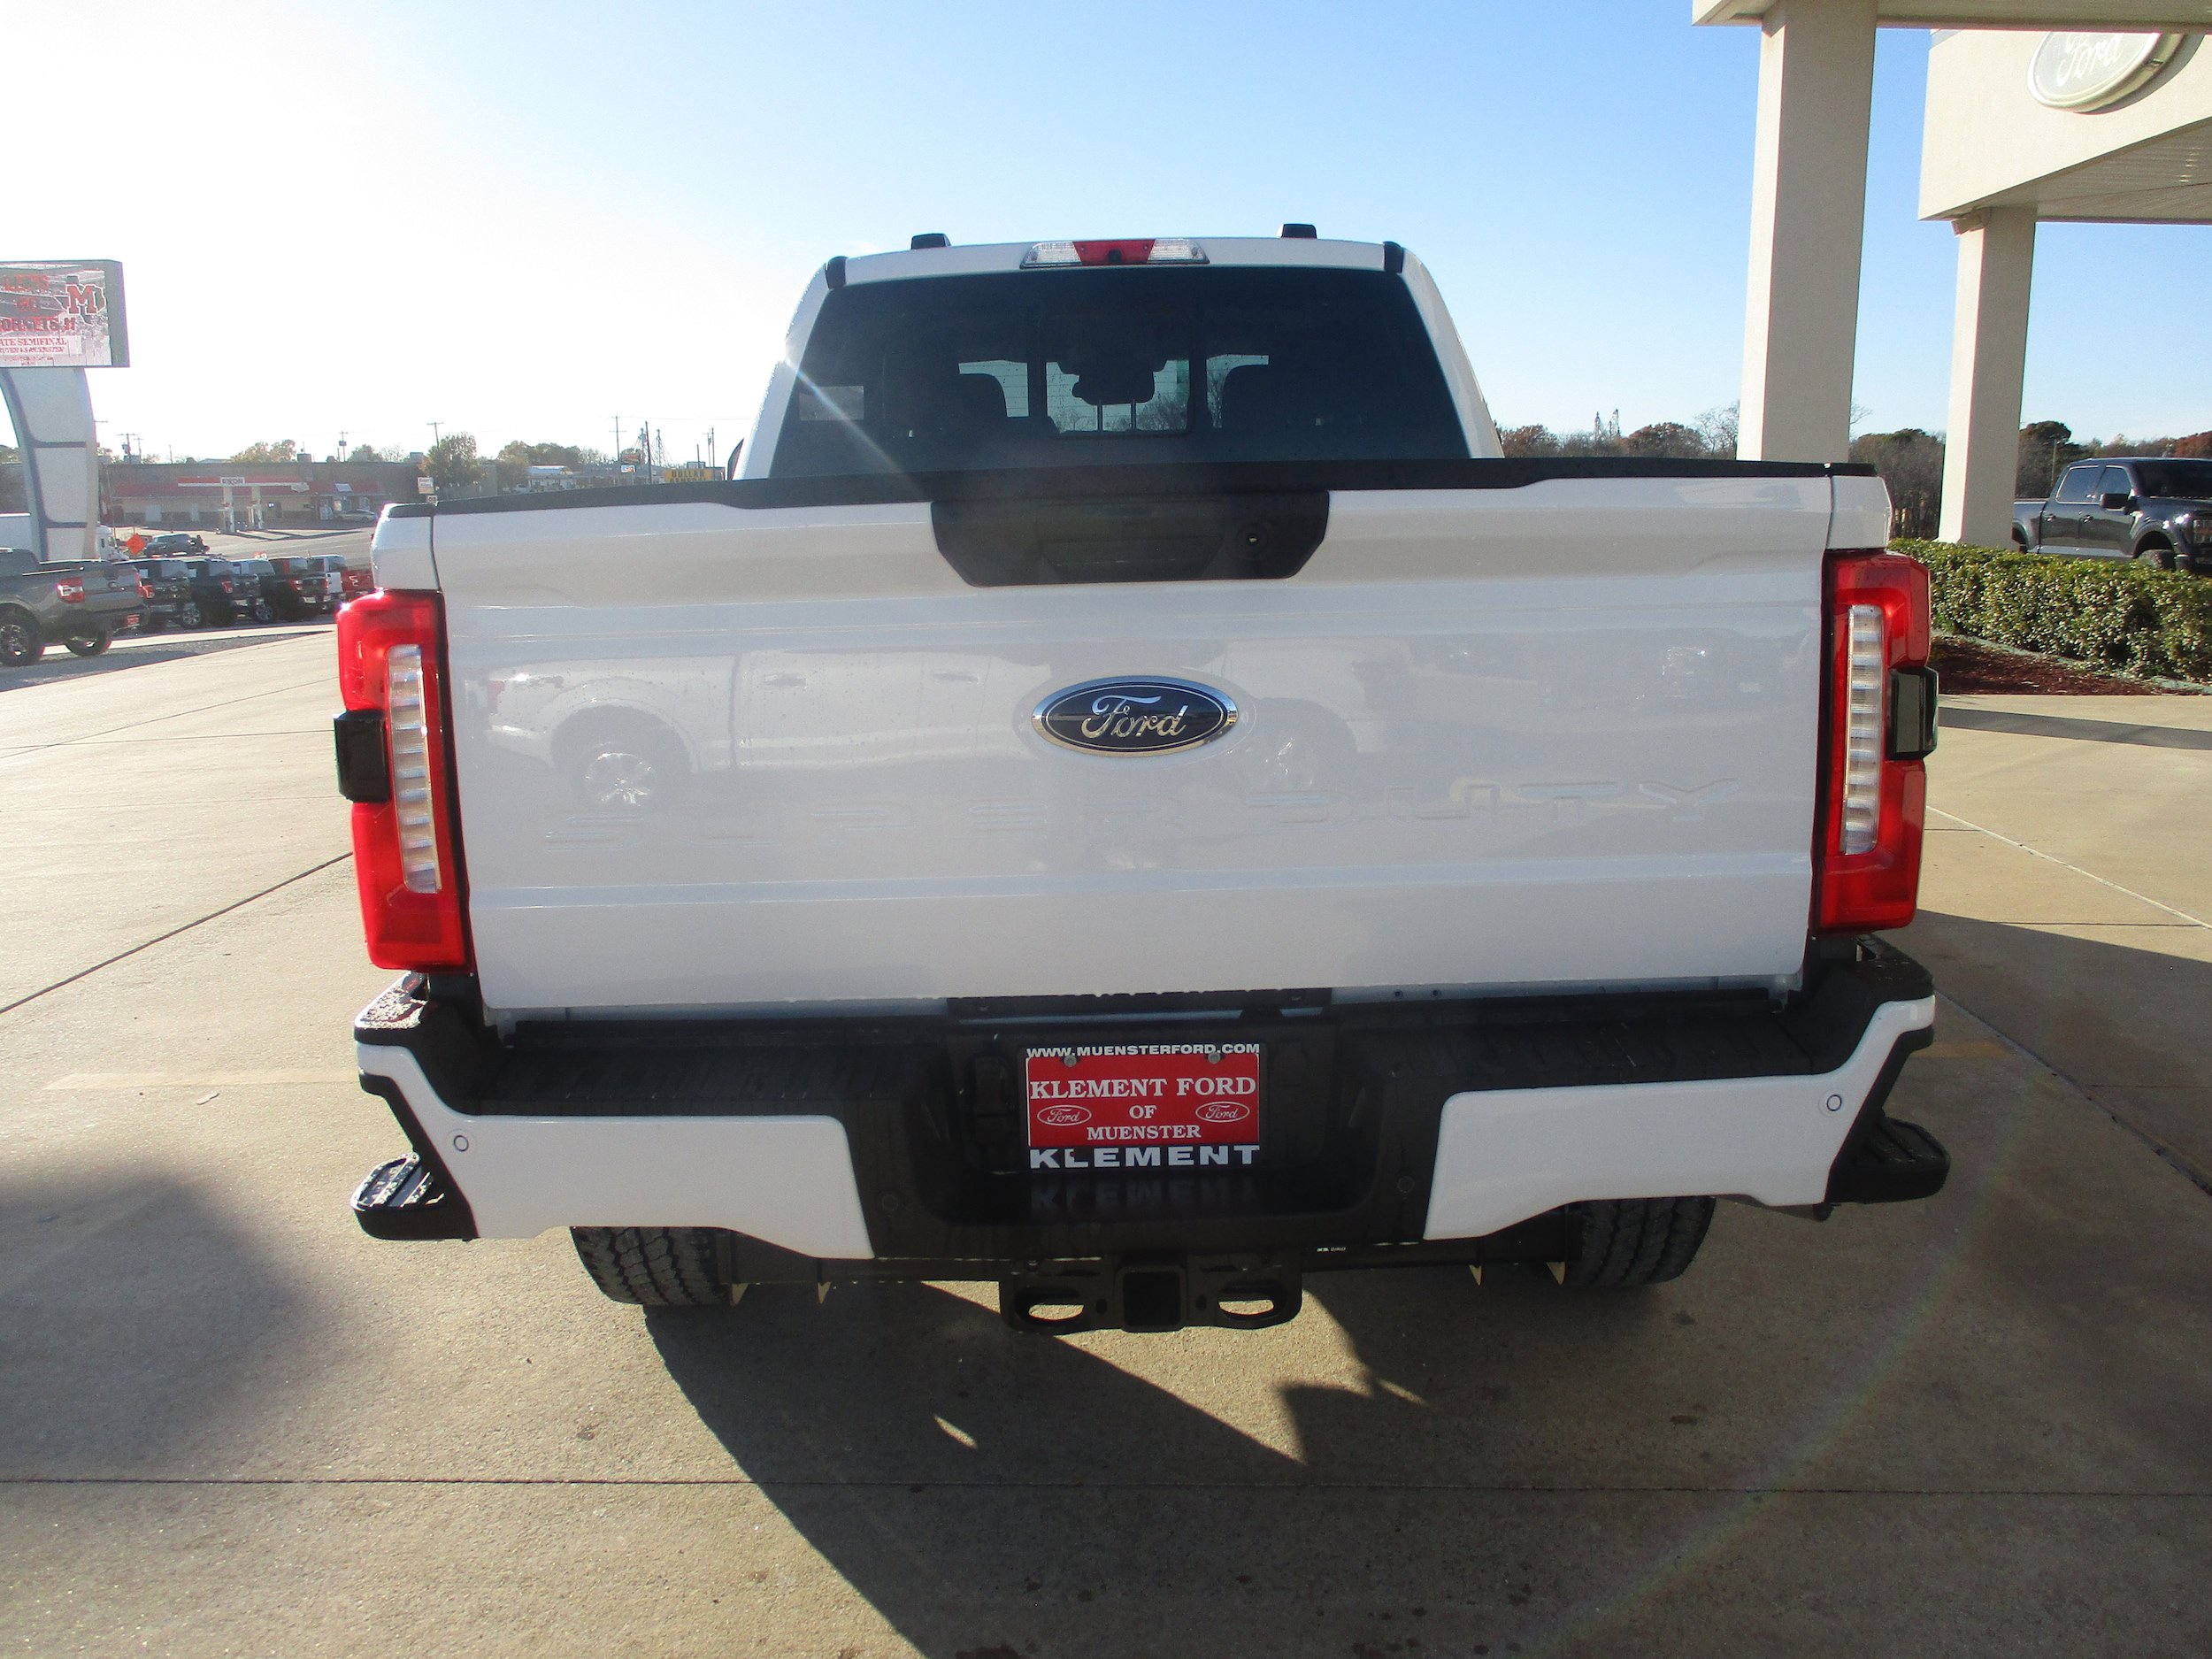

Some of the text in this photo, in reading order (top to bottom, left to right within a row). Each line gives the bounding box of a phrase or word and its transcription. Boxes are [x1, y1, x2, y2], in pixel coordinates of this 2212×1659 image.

[2057, 33, 2123, 87] Ford
[66, 284, 98, 315] M
[18, 337, 66, 346] SEMIFINAL
[1080, 695, 1188, 739] Ford
[1026, 1043, 1260, 1058] WWW.MUENSTERFORD.COM
[1030, 1077, 1256, 1099] KLEMENT FORD
[1047, 1108, 1081, 1123] Ford
[1129, 1105, 1157, 1119] OF
[1205, 1104, 1240, 1120] Ford
[1087, 1125, 1202, 1141] MUENSTER
[1030, 1144, 1260, 1169] KLEMENT
